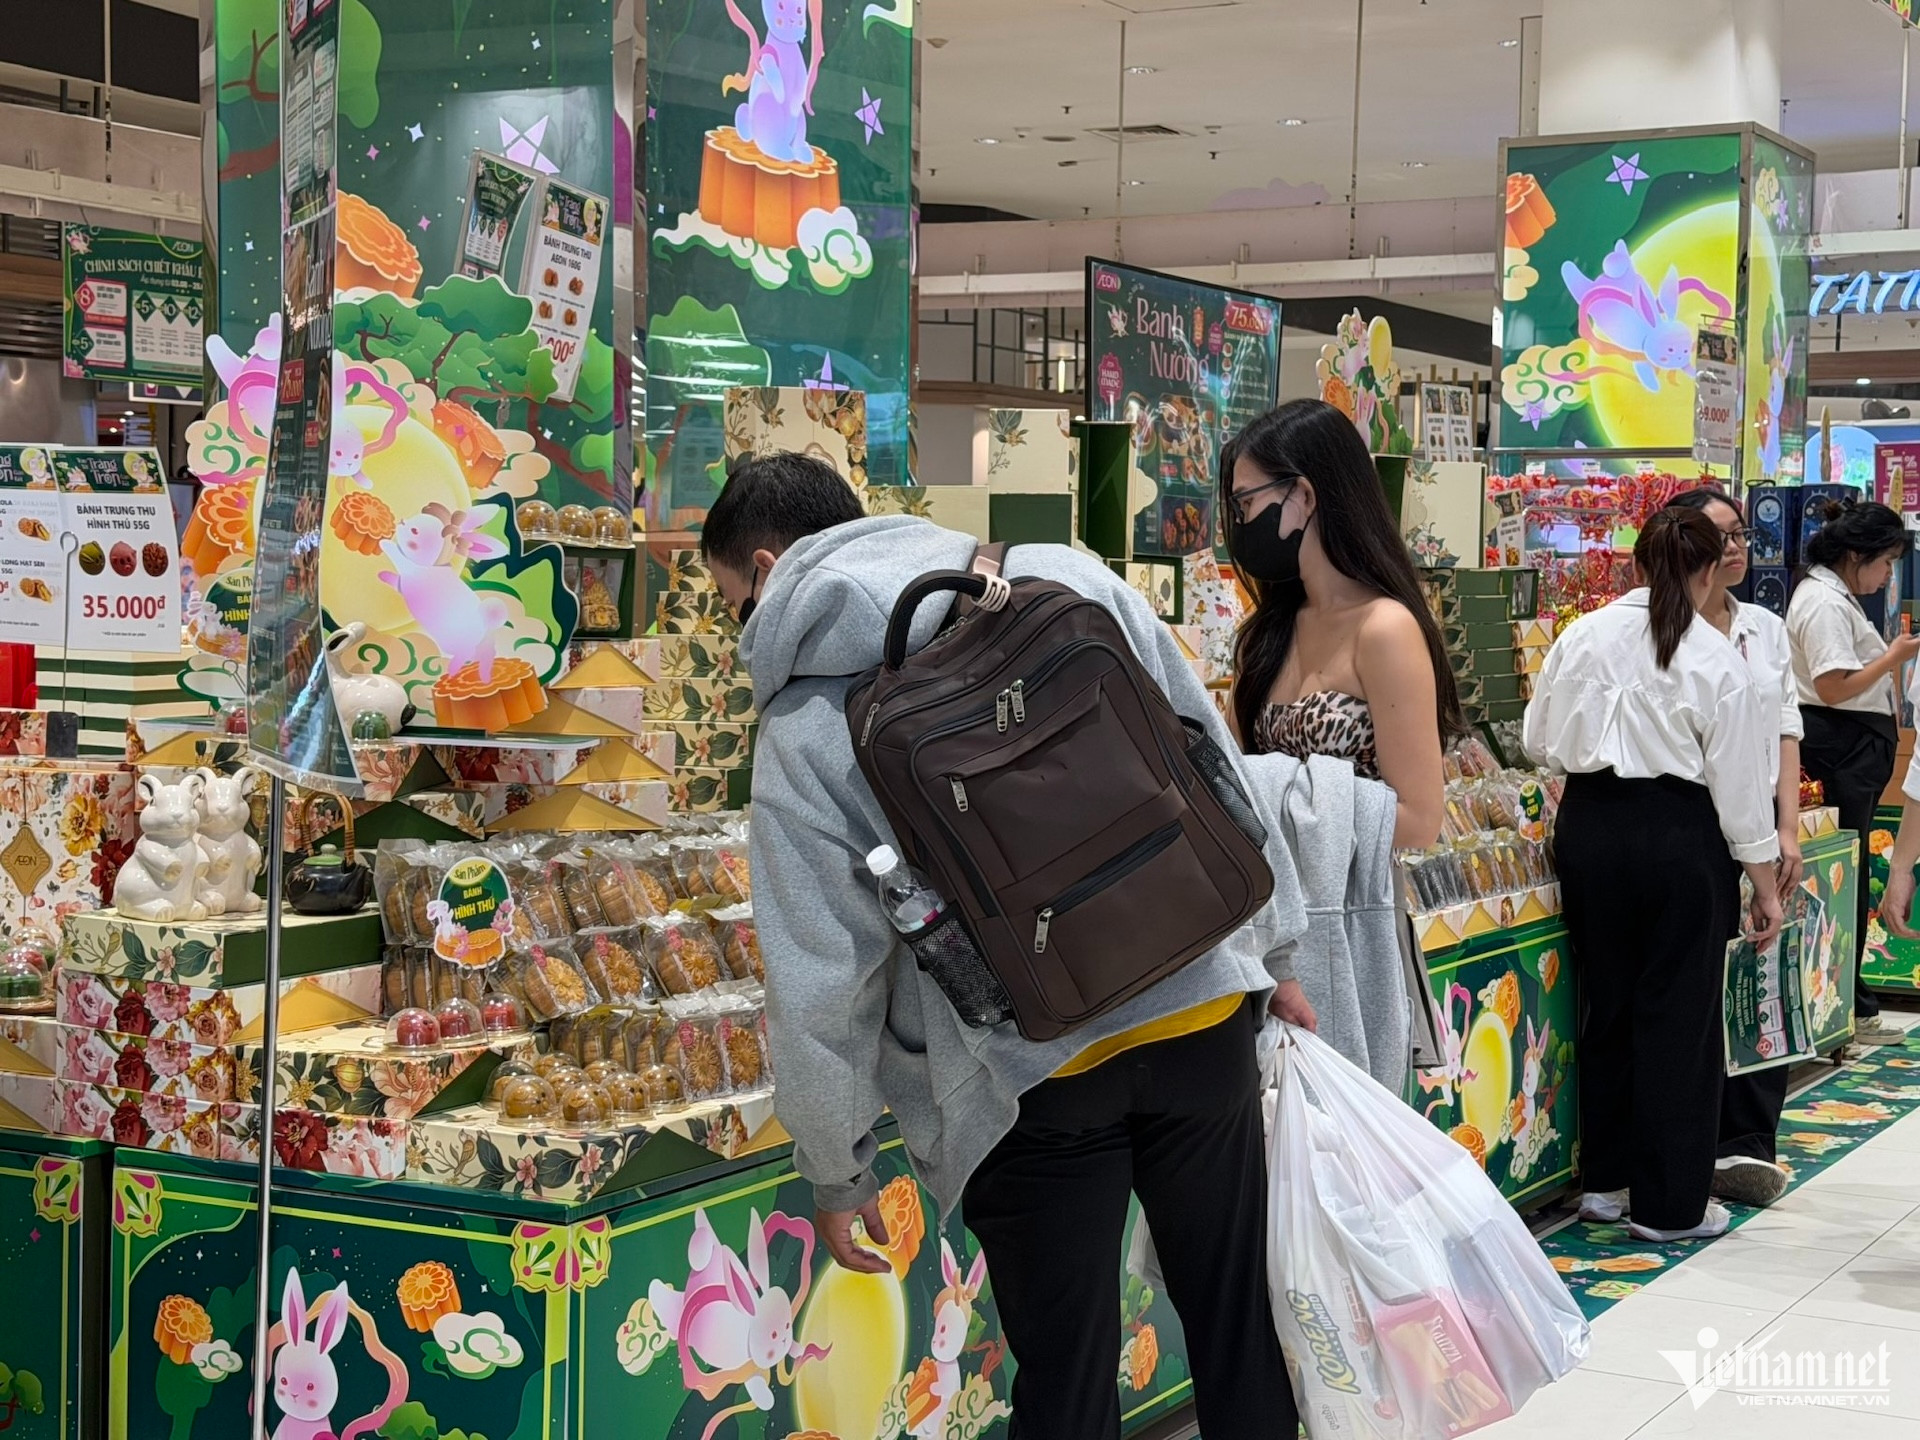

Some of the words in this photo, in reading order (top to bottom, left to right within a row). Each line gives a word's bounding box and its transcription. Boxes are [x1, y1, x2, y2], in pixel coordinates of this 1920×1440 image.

[117, 259, 142, 272] SÁCH
[1136, 296, 1185, 340] Bánh
[76, 504, 102, 515] BÁNH
[104, 505, 135, 515] TRUNG
[136, 506, 156, 516] THU
[86, 518, 111, 529] HÌNH
[112, 518, 131, 529] THÚ
[132, 519, 150, 530] 55G
[82, 594, 166, 620] 35.000đ
[453, 902, 477, 920] HÌNH
